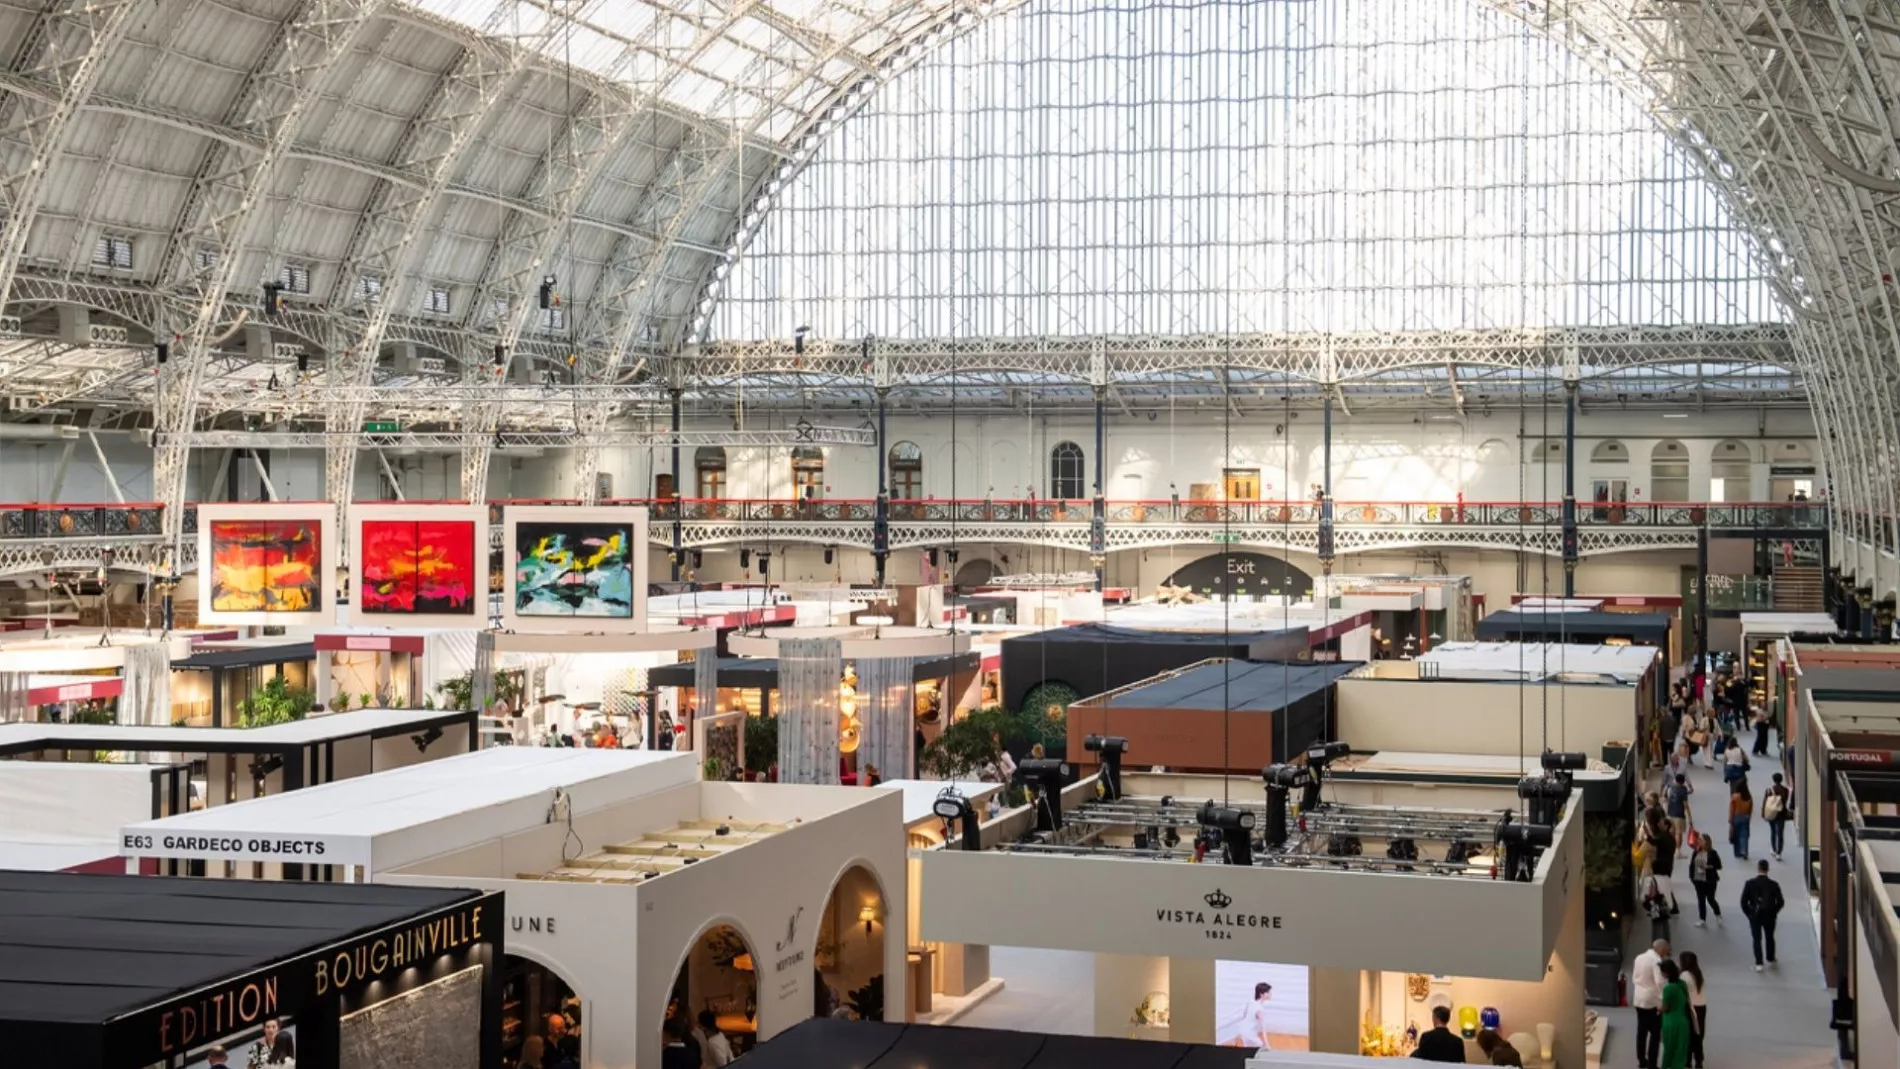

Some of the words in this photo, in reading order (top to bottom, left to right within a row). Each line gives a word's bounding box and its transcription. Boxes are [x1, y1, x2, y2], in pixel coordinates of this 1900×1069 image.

[1227, 559, 1256, 575] Exit
[1829, 752, 1883, 762] PORTUGAL
[124, 835, 153, 849] E63
[163, 836, 243, 851] GARDECO
[248, 839, 325, 855] OBJECTS
[1156, 909, 1205, 924] VISTA
[1213, 913, 1282, 929] ALEGRE
[1205, 930, 1231, 940] 1824
[315, 905, 483, 996] BOUGAINVILLE
[159, 975, 278, 1051] EDITION
